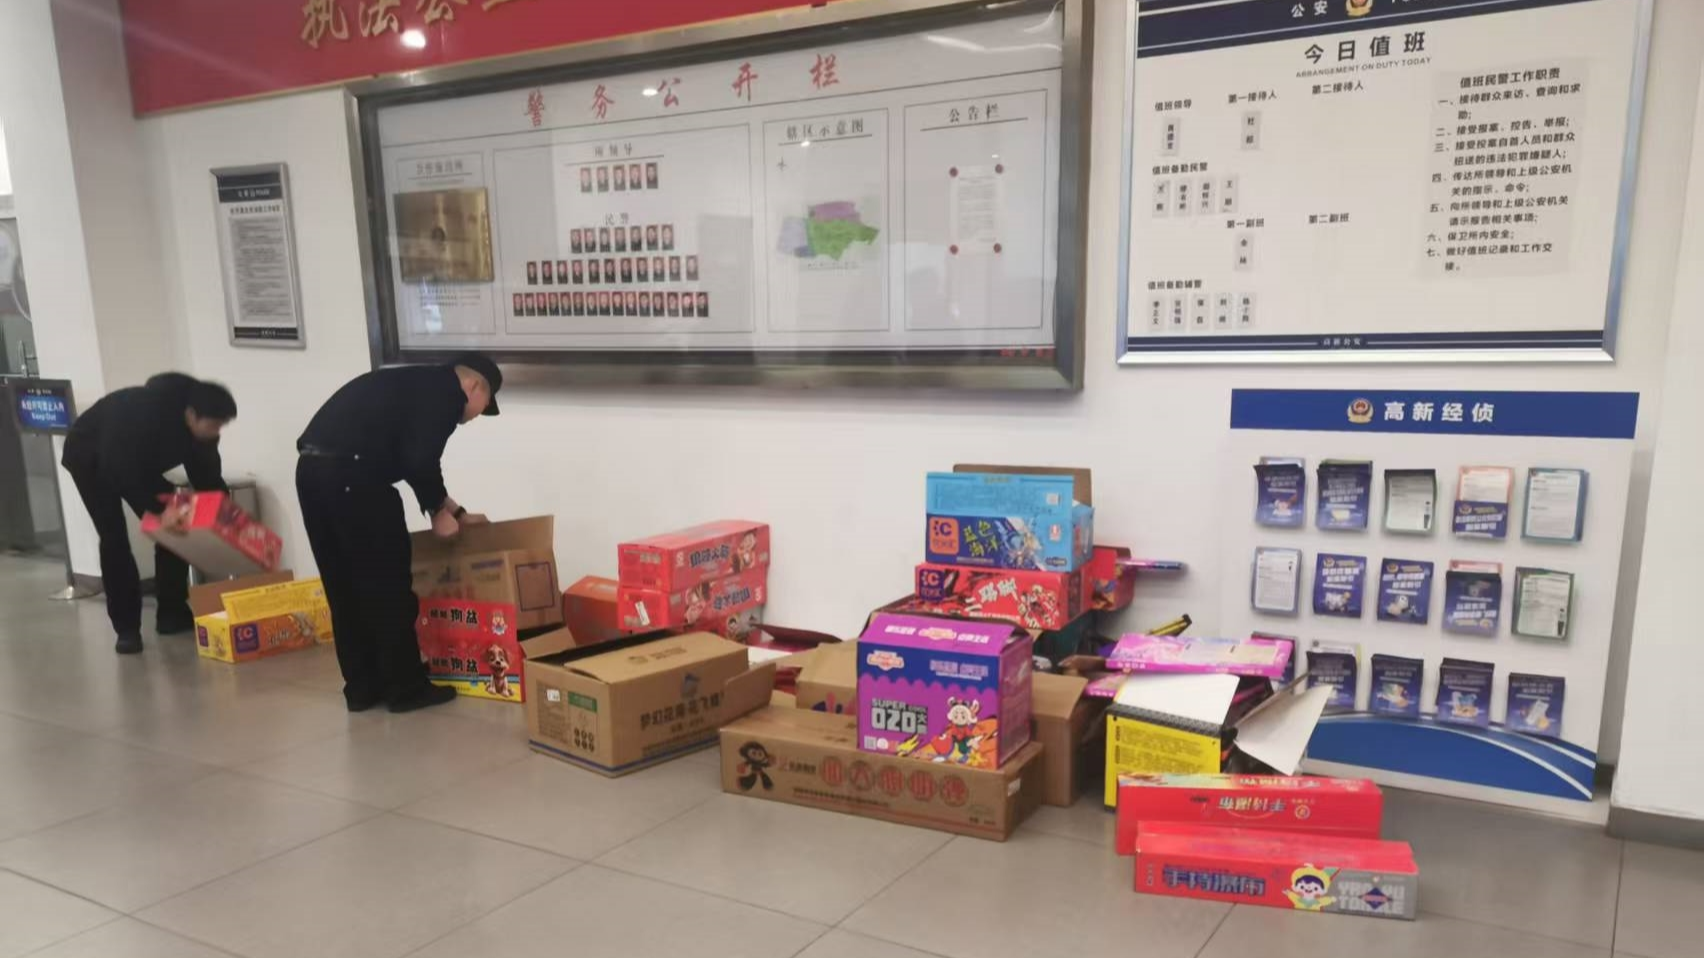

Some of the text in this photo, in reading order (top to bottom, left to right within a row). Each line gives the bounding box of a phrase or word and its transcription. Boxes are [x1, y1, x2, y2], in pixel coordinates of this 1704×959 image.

[1290, 1, 1328, 18] 公安
[1304, 31, 1426, 65] 今日值班
[1296, 57, 1432, 78] ARRANGEMENT ON DUTY TODAY
[1311, 80, 1364, 96] 第二接待人
[1459, 68, 1561, 89] 值班民警工作职责
[523, 52, 841, 127] 警务公开栏
[1228, 90, 1277, 104] 第一接待人
[1437, 83, 1581, 107] 一、接待群众来访、查询和求
[948, 103, 1000, 124] 公告栏
[1154, 99, 1192, 111] 值班领导
[785, 118, 864, 141] 辖区示意图
[1433, 132, 1576, 153] 三、接受投案自首人员和群众
[1431, 164, 1572, 183] 四、传达所领导和上级公安机
[1429, 195, 1569, 213] 五、向所领导和上级公安机关
[1383, 401, 1495, 424] 高新经侦
